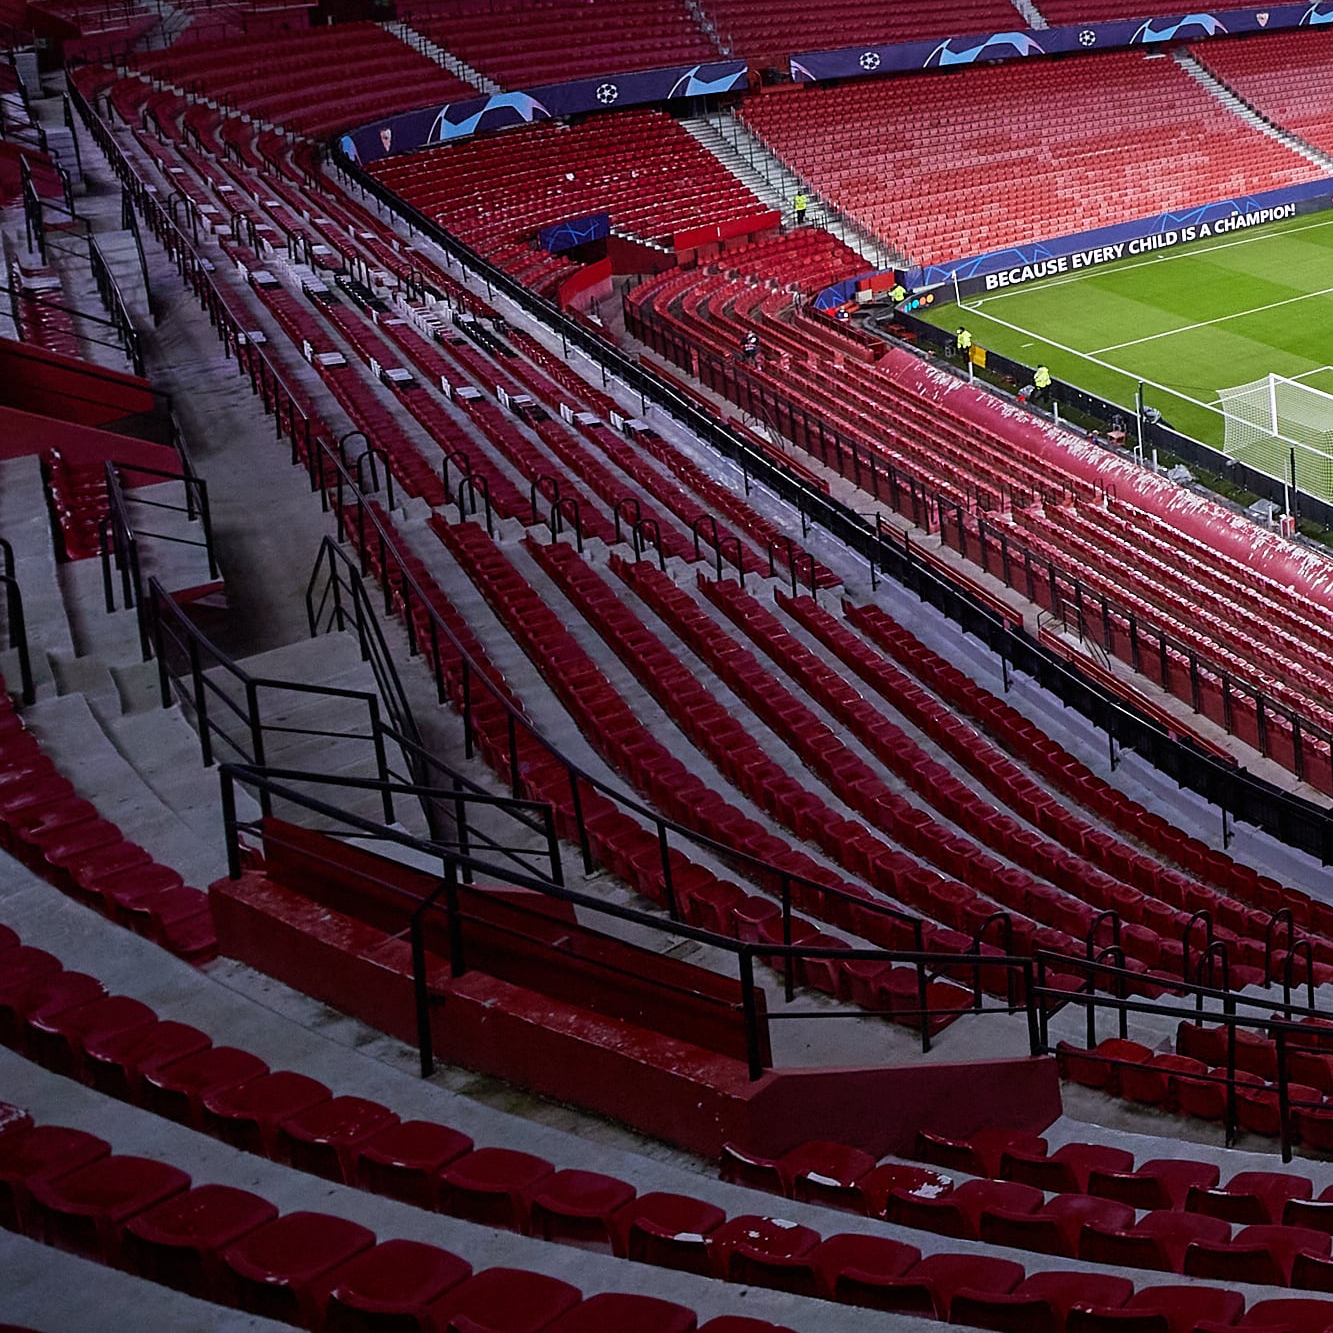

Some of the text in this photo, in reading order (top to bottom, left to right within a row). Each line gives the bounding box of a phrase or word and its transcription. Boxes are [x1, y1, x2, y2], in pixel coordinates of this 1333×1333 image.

[985, 257, 1069, 291] BECAUSE
[1071, 243, 1125, 270] EVERY
[1128, 231, 1178, 255] CHILD
[1181, 226, 1196, 242] IS
[1199, 223, 1212, 238] A
